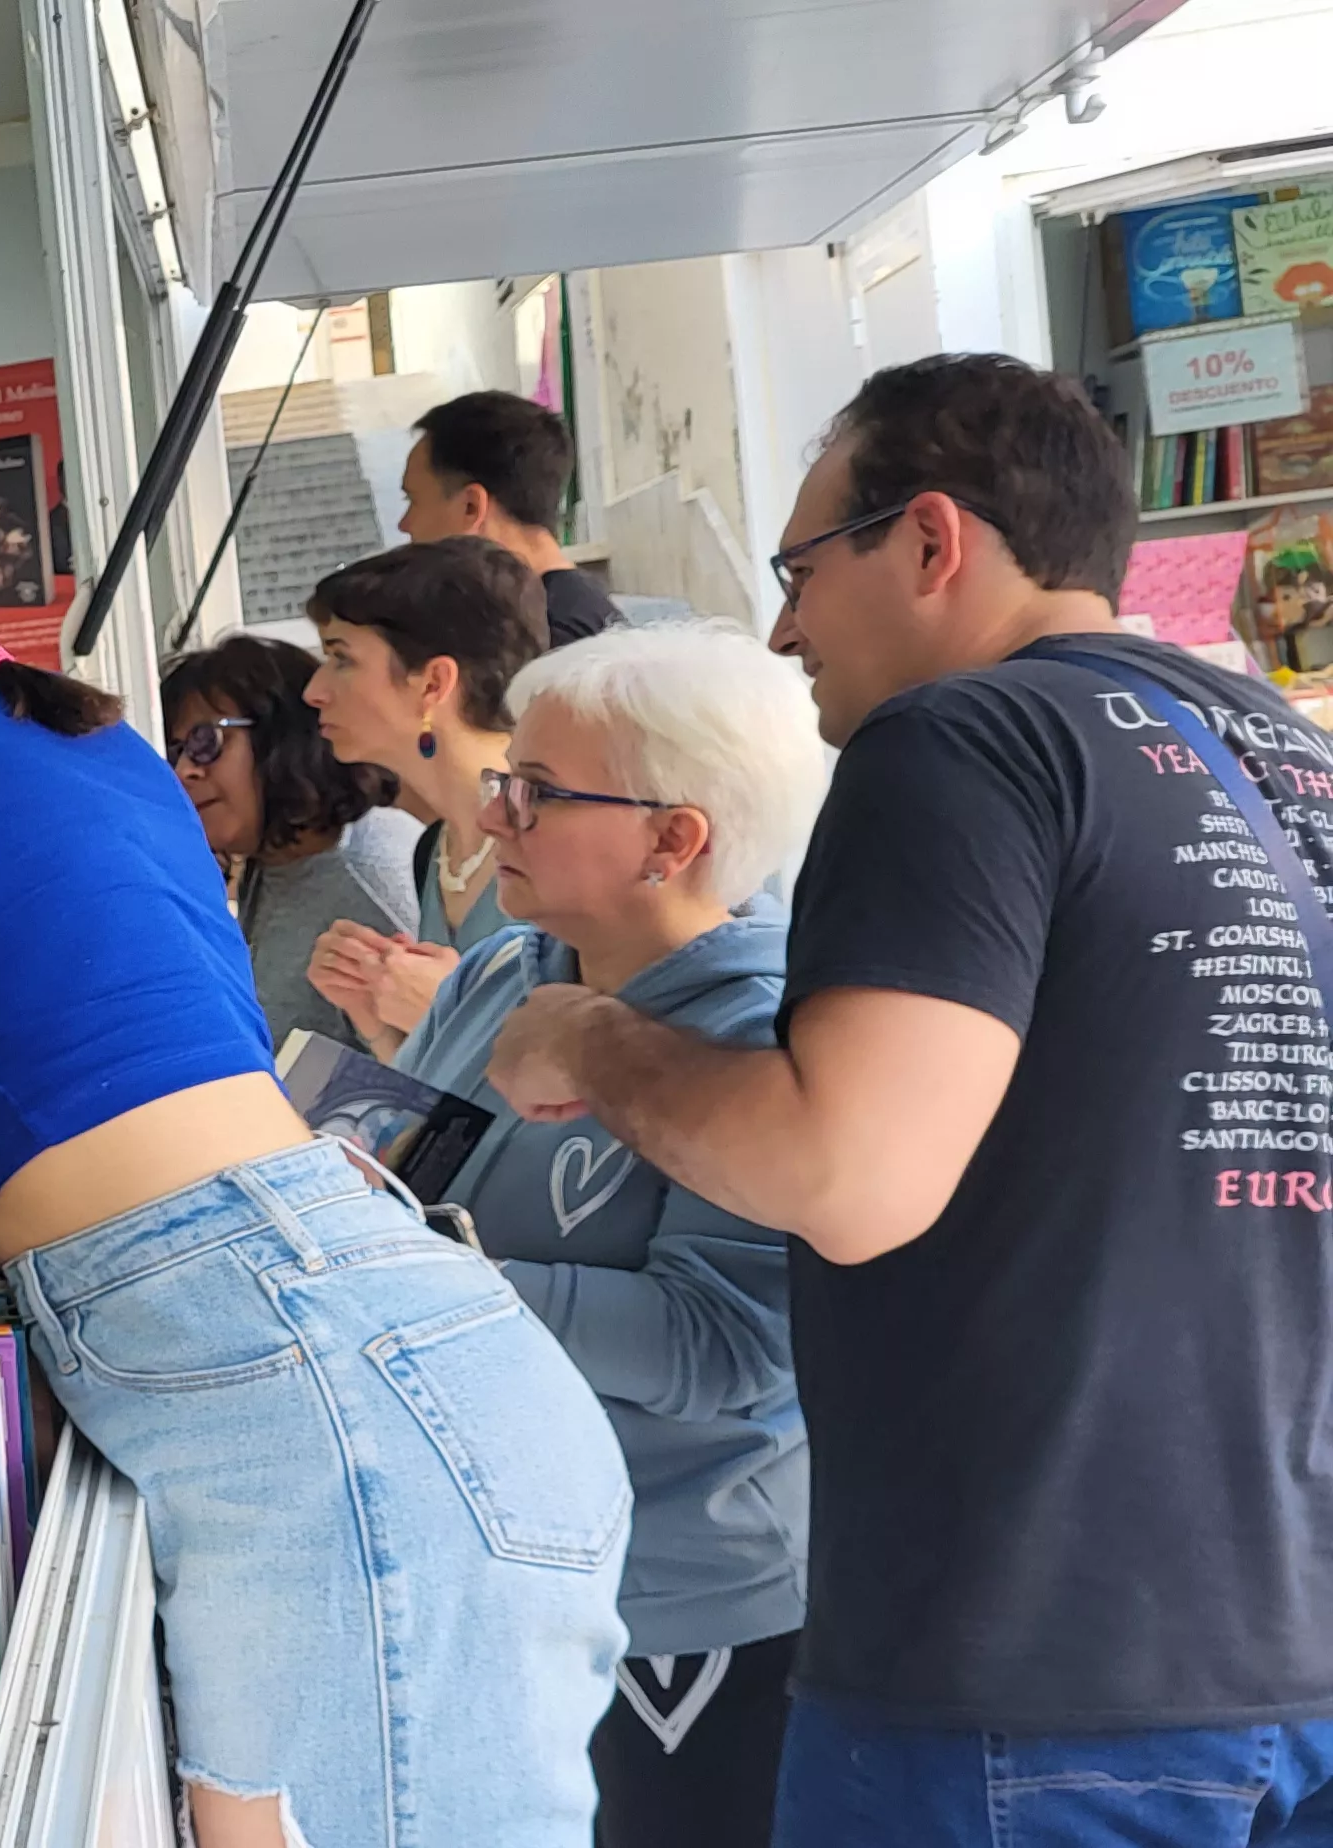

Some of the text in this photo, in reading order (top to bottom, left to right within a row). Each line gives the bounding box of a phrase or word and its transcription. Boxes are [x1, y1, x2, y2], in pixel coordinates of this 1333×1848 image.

[1185, 349, 1256, 380] 10%
[1168, 377, 1280, 405] DESCUENTO
[1150, 929, 1197, 953] ST.
[1207, 1100, 1331, 1124] BARCELO
